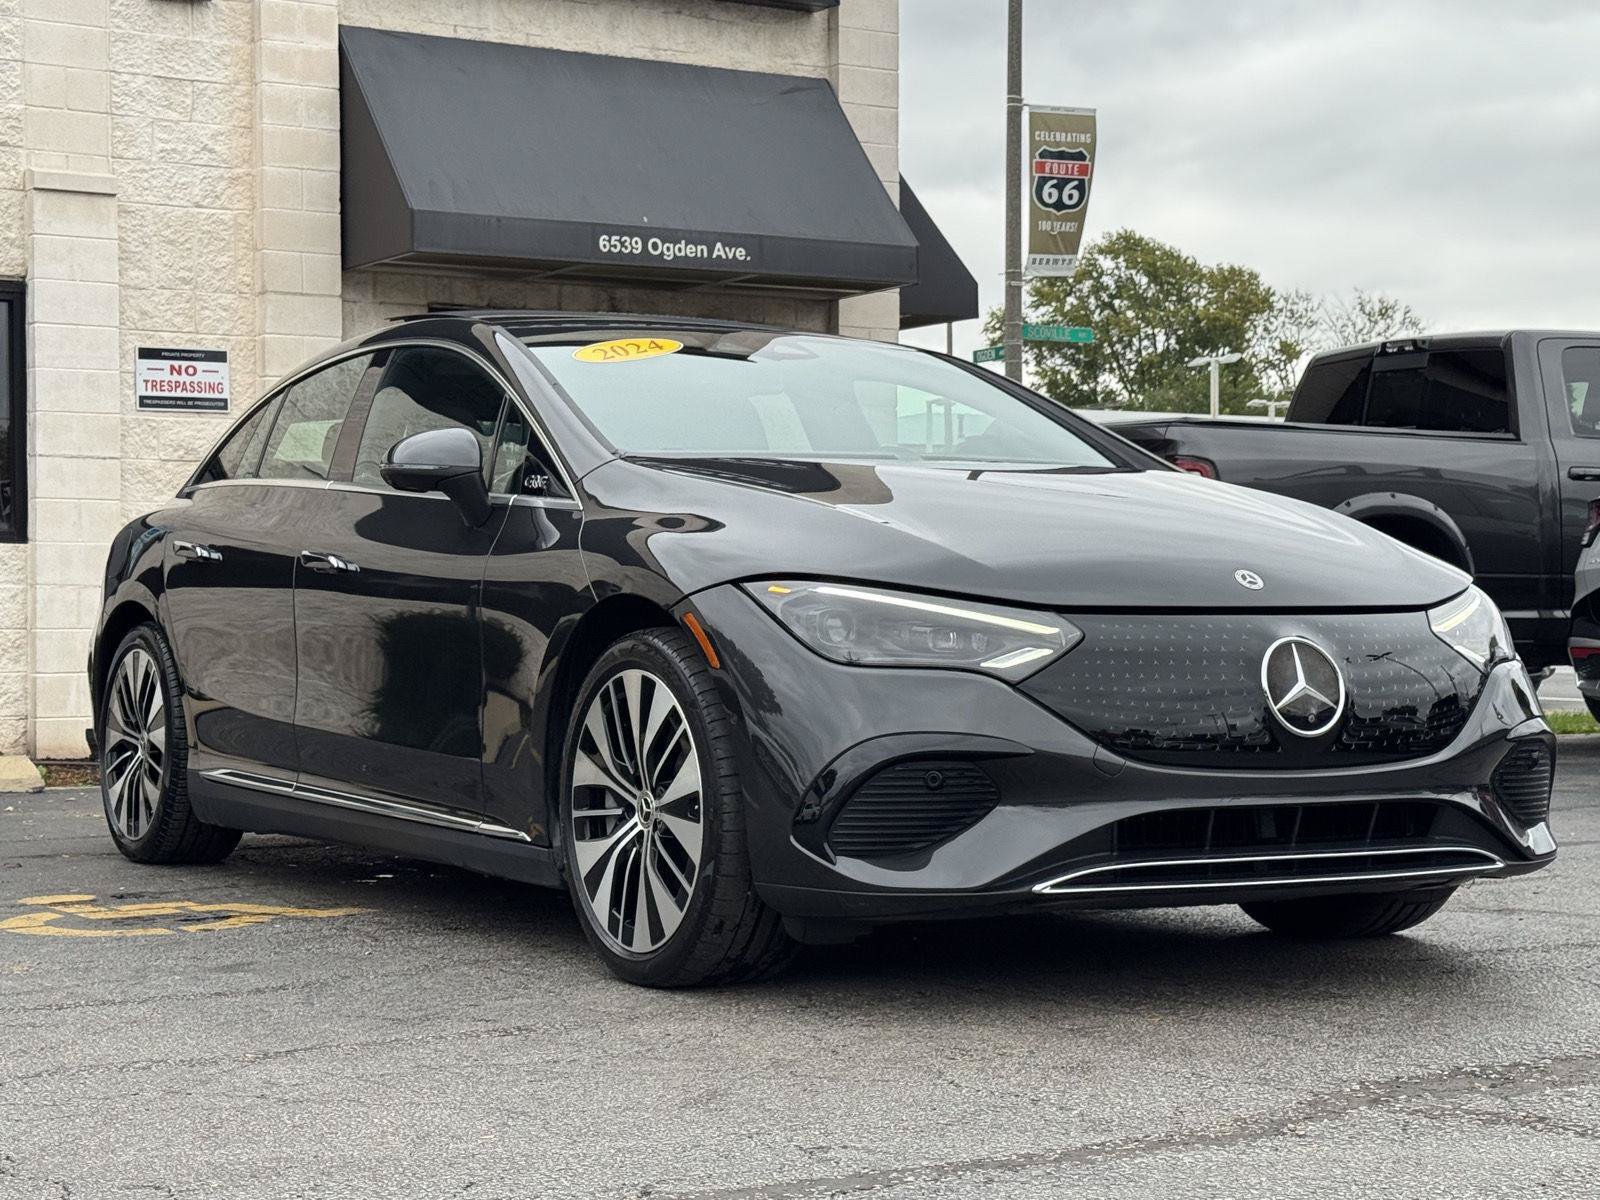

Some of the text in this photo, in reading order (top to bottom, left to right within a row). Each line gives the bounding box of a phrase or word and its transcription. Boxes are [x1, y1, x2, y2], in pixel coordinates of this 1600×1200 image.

[1035, 131, 1092, 143] CELEBRATING
[1045, 163, 1080, 175] ROUTE
[1042, 179, 1080, 206] 66
[1038, 221, 1051, 231] 100
[599, 235, 751, 261] 6539 Ogden Ave.
[1028, 326, 1071, 339] SCOVILLE
[592, 340, 664, 360] 2024
[169, 364, 198, 376] NO
[143, 380, 224, 394] TRESPASSING
